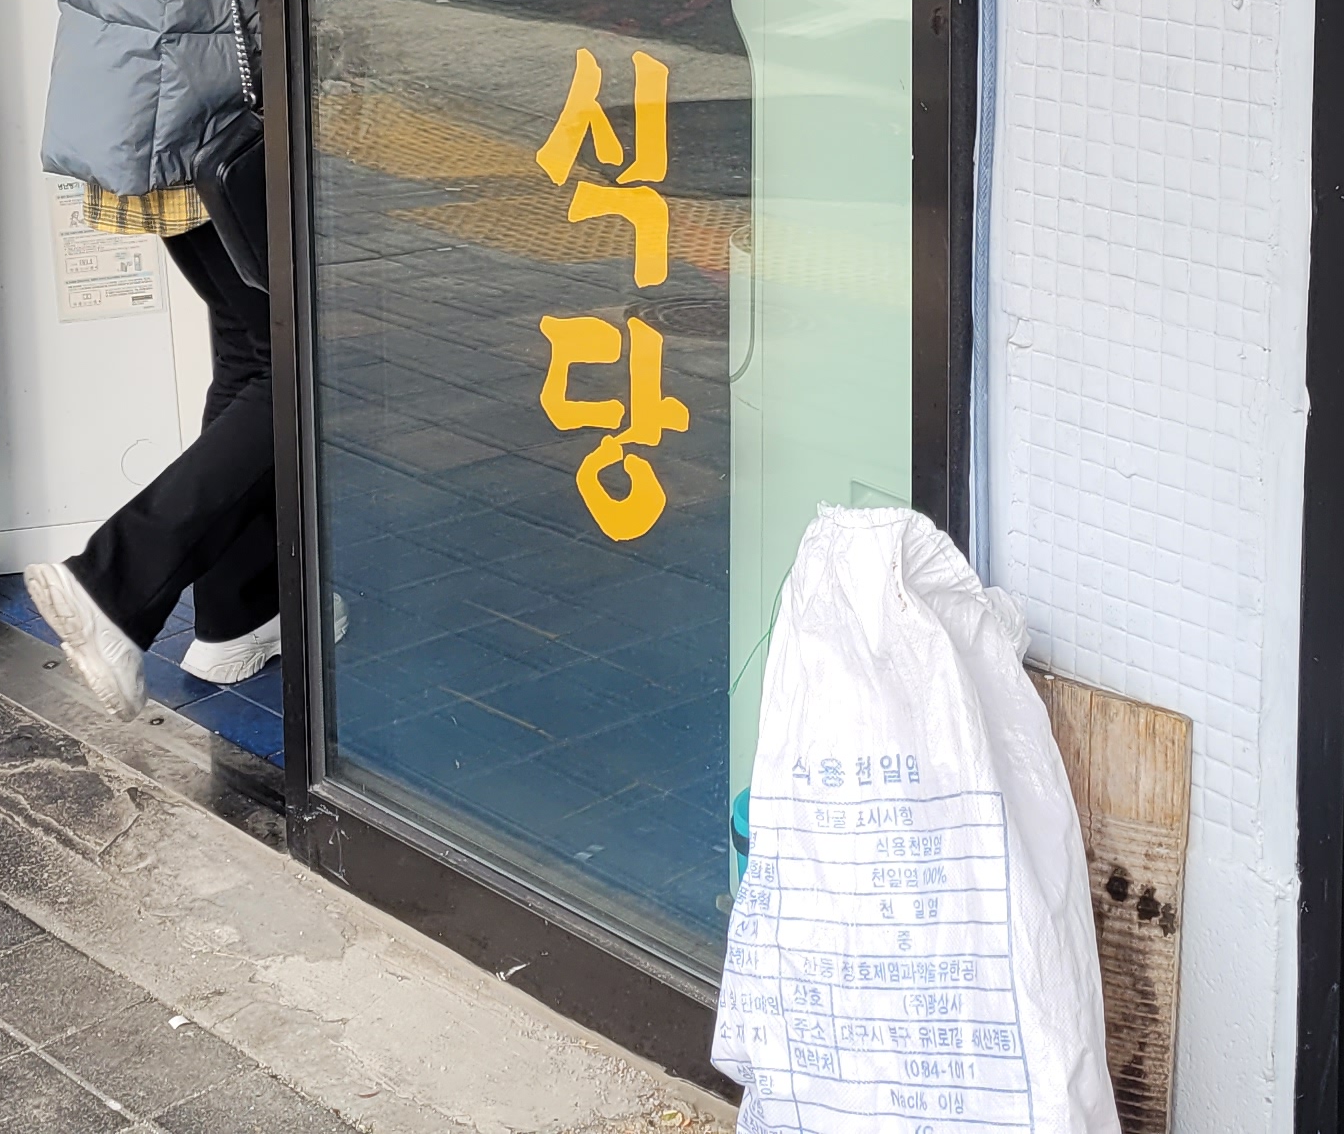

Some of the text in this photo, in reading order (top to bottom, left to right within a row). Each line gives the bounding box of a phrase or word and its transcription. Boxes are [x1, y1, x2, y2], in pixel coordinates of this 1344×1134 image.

[871, 867, 920, 889] 천일염
[793, 984, 825, 1008] 상호
[793, 1017, 827, 1042] 주소
[840, 1024, 884, 1046] 대구시
[794, 1046, 836, 1074] 연락처
[938, 1093, 965, 1116] 이상
